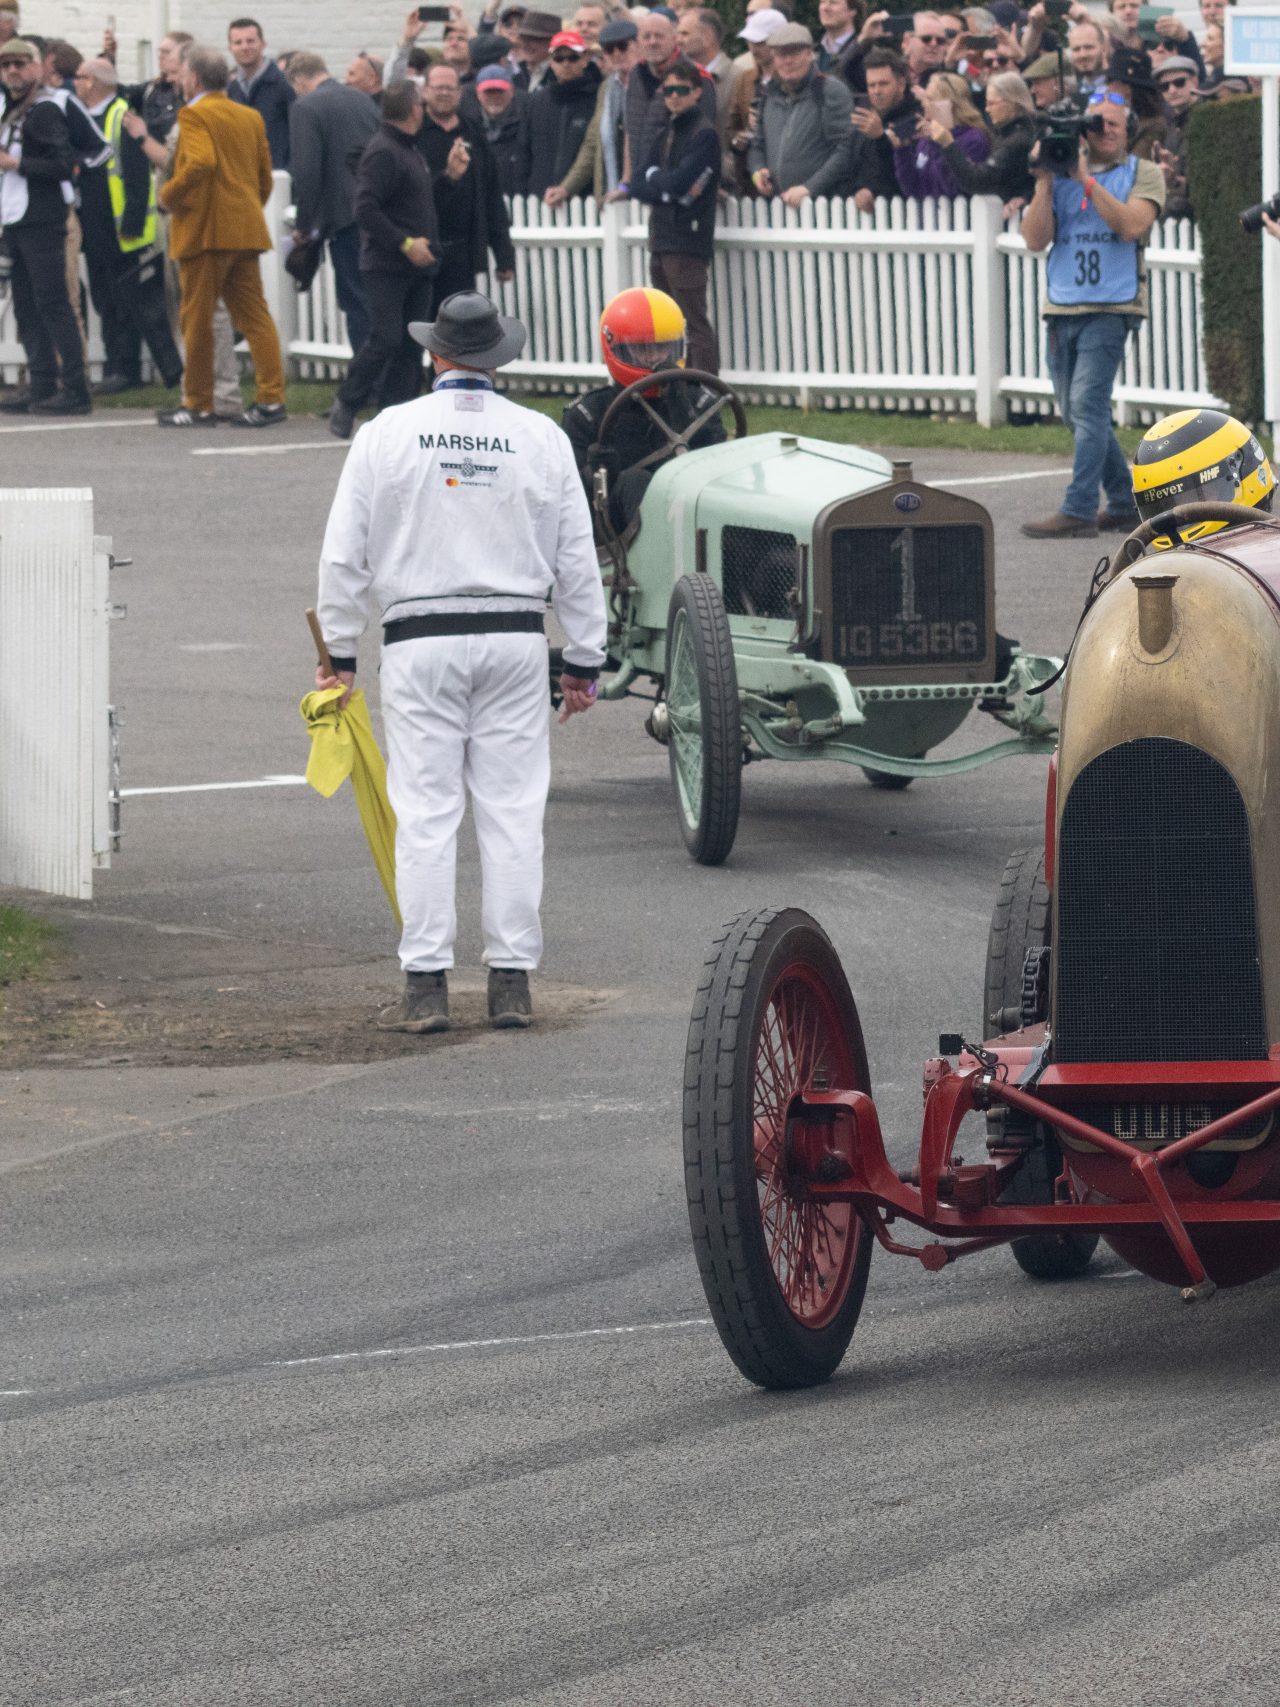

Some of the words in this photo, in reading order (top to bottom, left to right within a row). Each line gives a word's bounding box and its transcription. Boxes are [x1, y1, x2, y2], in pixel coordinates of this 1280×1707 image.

[1075, 250, 1101, 286] 38
[419, 434, 516, 454] MARSHAL
[1144, 482, 1184, 503] #Fever
[891, 527, 922, 622] 1
[879, 620, 978, 656] 5366
